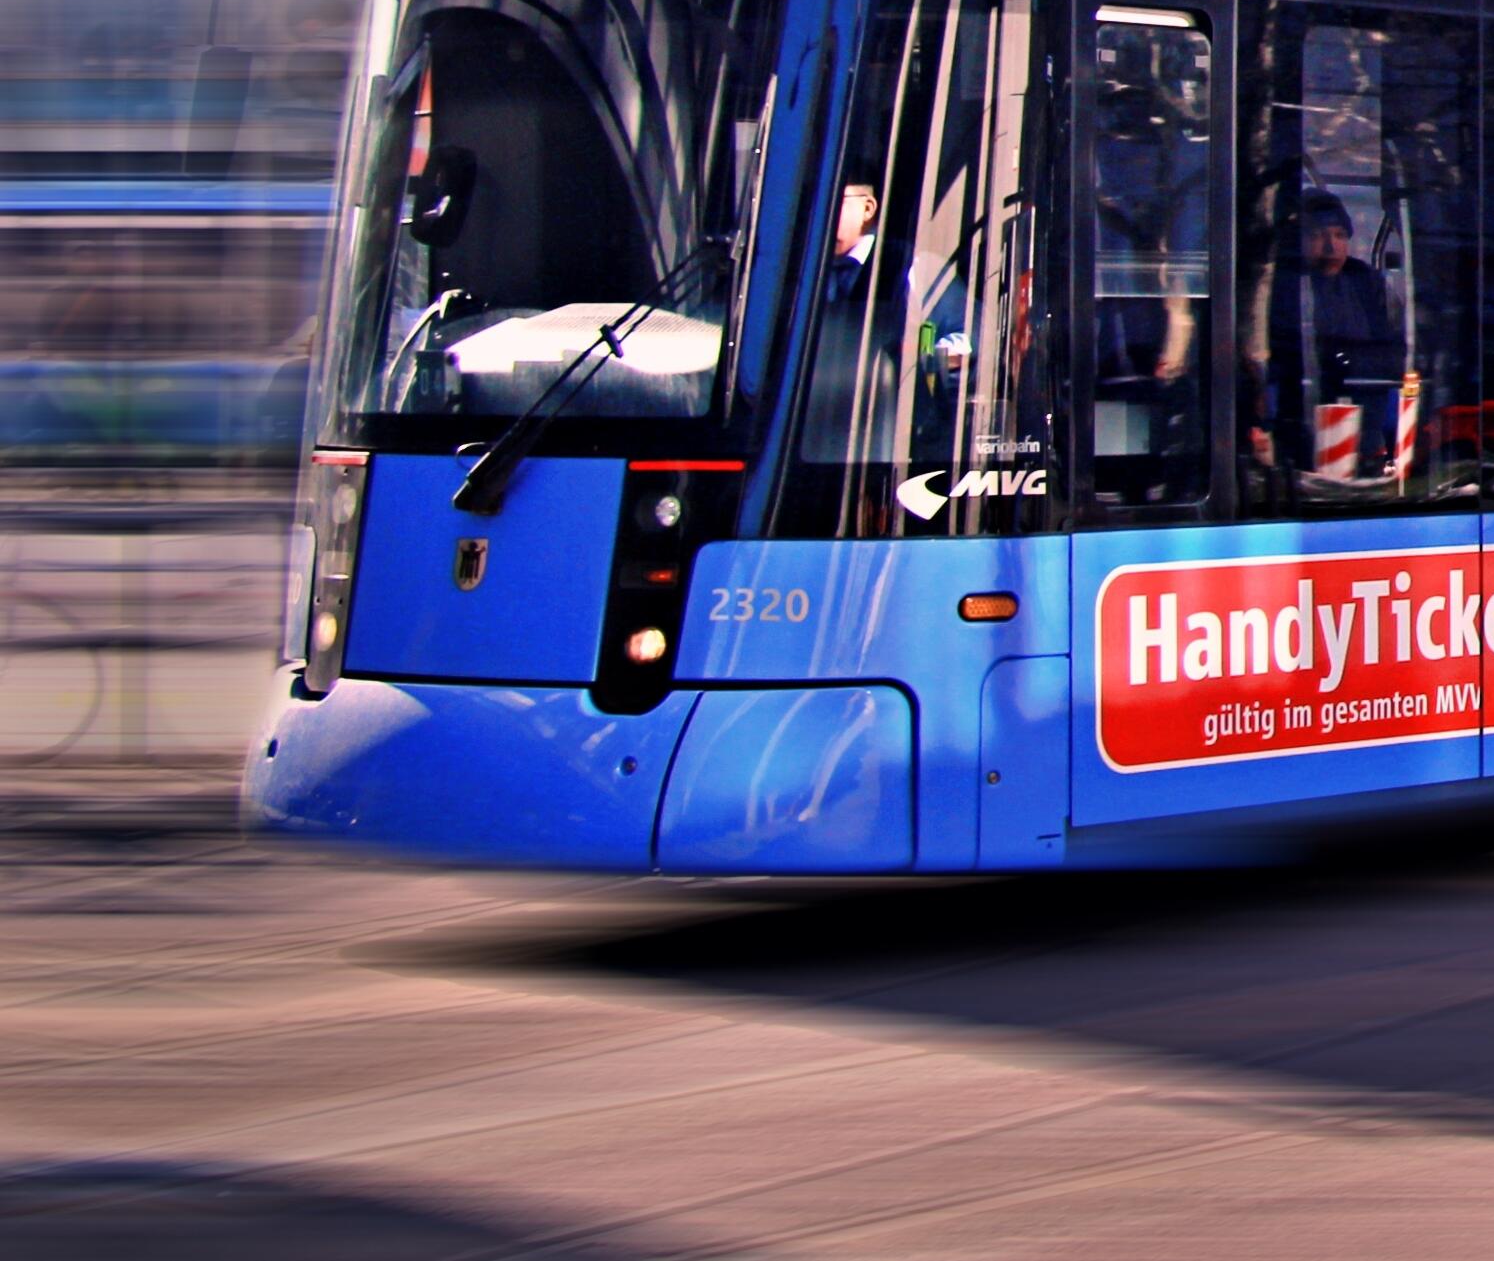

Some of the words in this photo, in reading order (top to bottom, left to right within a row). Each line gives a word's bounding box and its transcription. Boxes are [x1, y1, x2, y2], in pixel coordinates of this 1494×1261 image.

[975, 434, 1041, 455] variobahn
[949, 470, 1047, 497] MVG
[709, 588, 809, 622] 2320
[1204, 701, 1275, 746] gültig
[1285, 698, 1312, 727] im
[1320, 691, 1428, 734] gesamten
